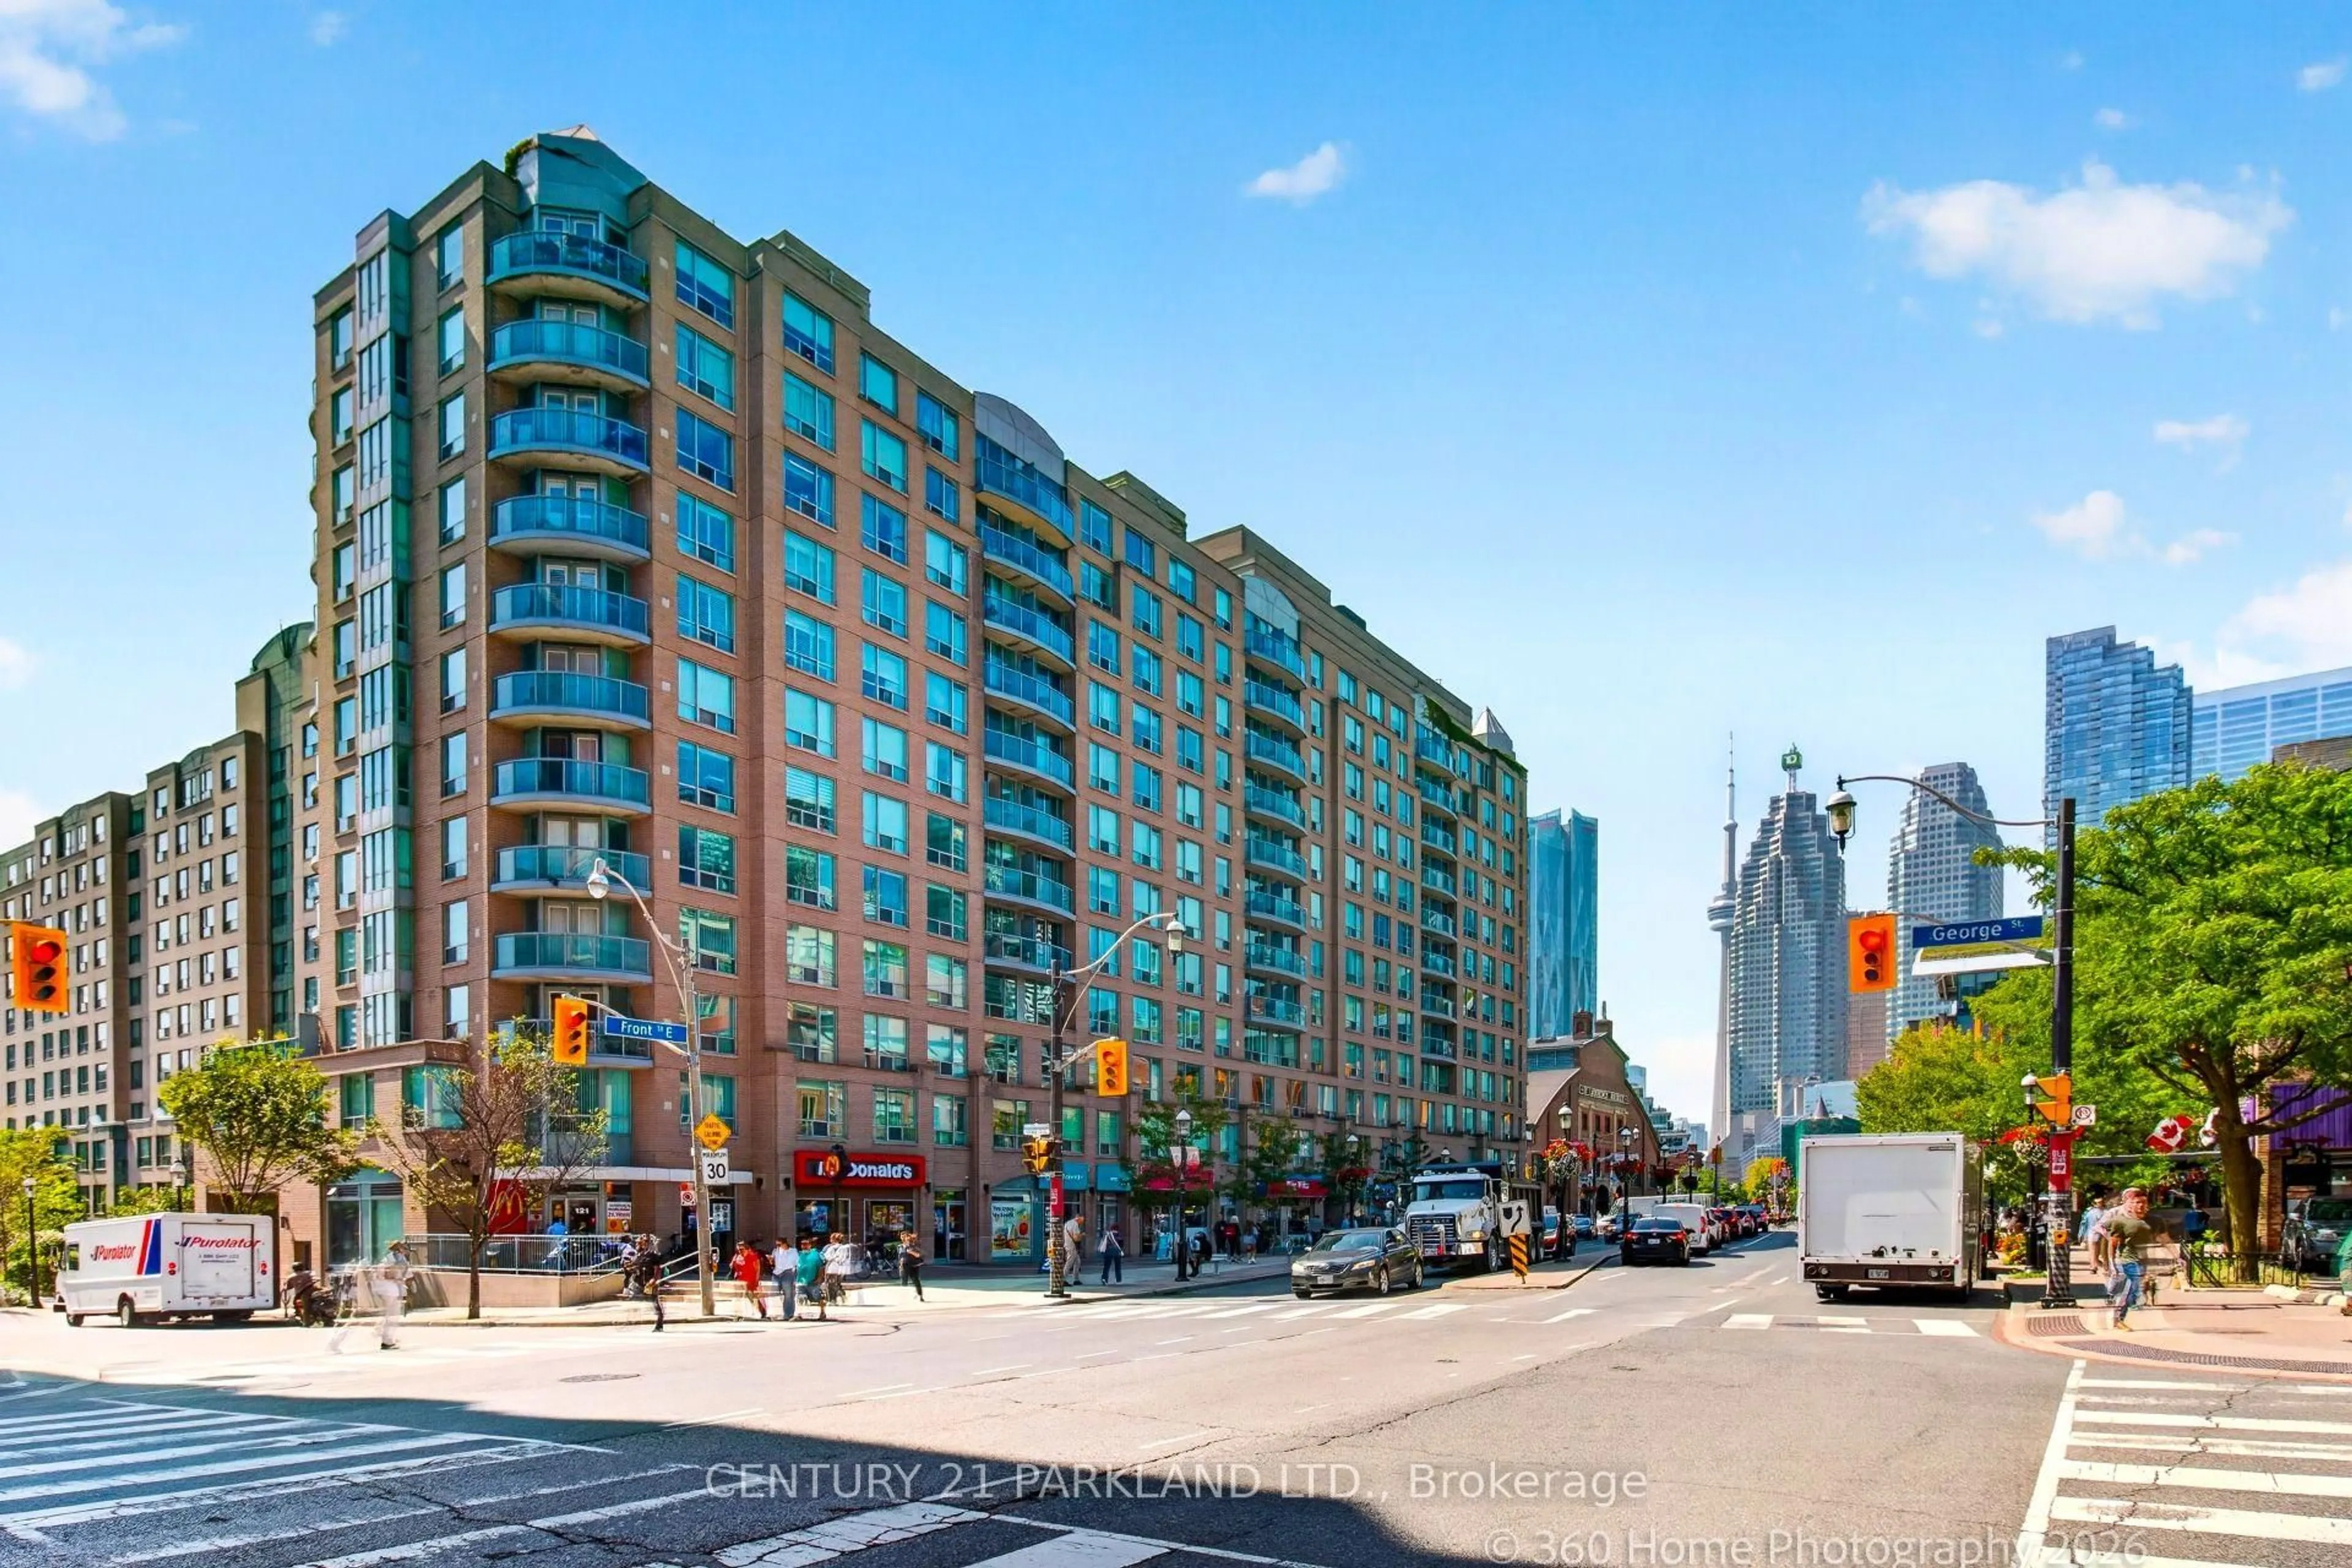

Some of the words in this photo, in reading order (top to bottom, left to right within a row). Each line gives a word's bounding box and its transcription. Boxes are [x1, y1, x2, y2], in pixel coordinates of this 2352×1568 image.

[1932, 924, 2002, 941] George
[621, 1020, 652, 1036] Front
[666, 1027, 673, 1039] E
[707, 1164, 726, 1179] 30
[818, 1161, 913, 1179] Donald's
[189, 1237, 262, 1248] Purolator
[98, 1245, 136, 1260] Purolator
